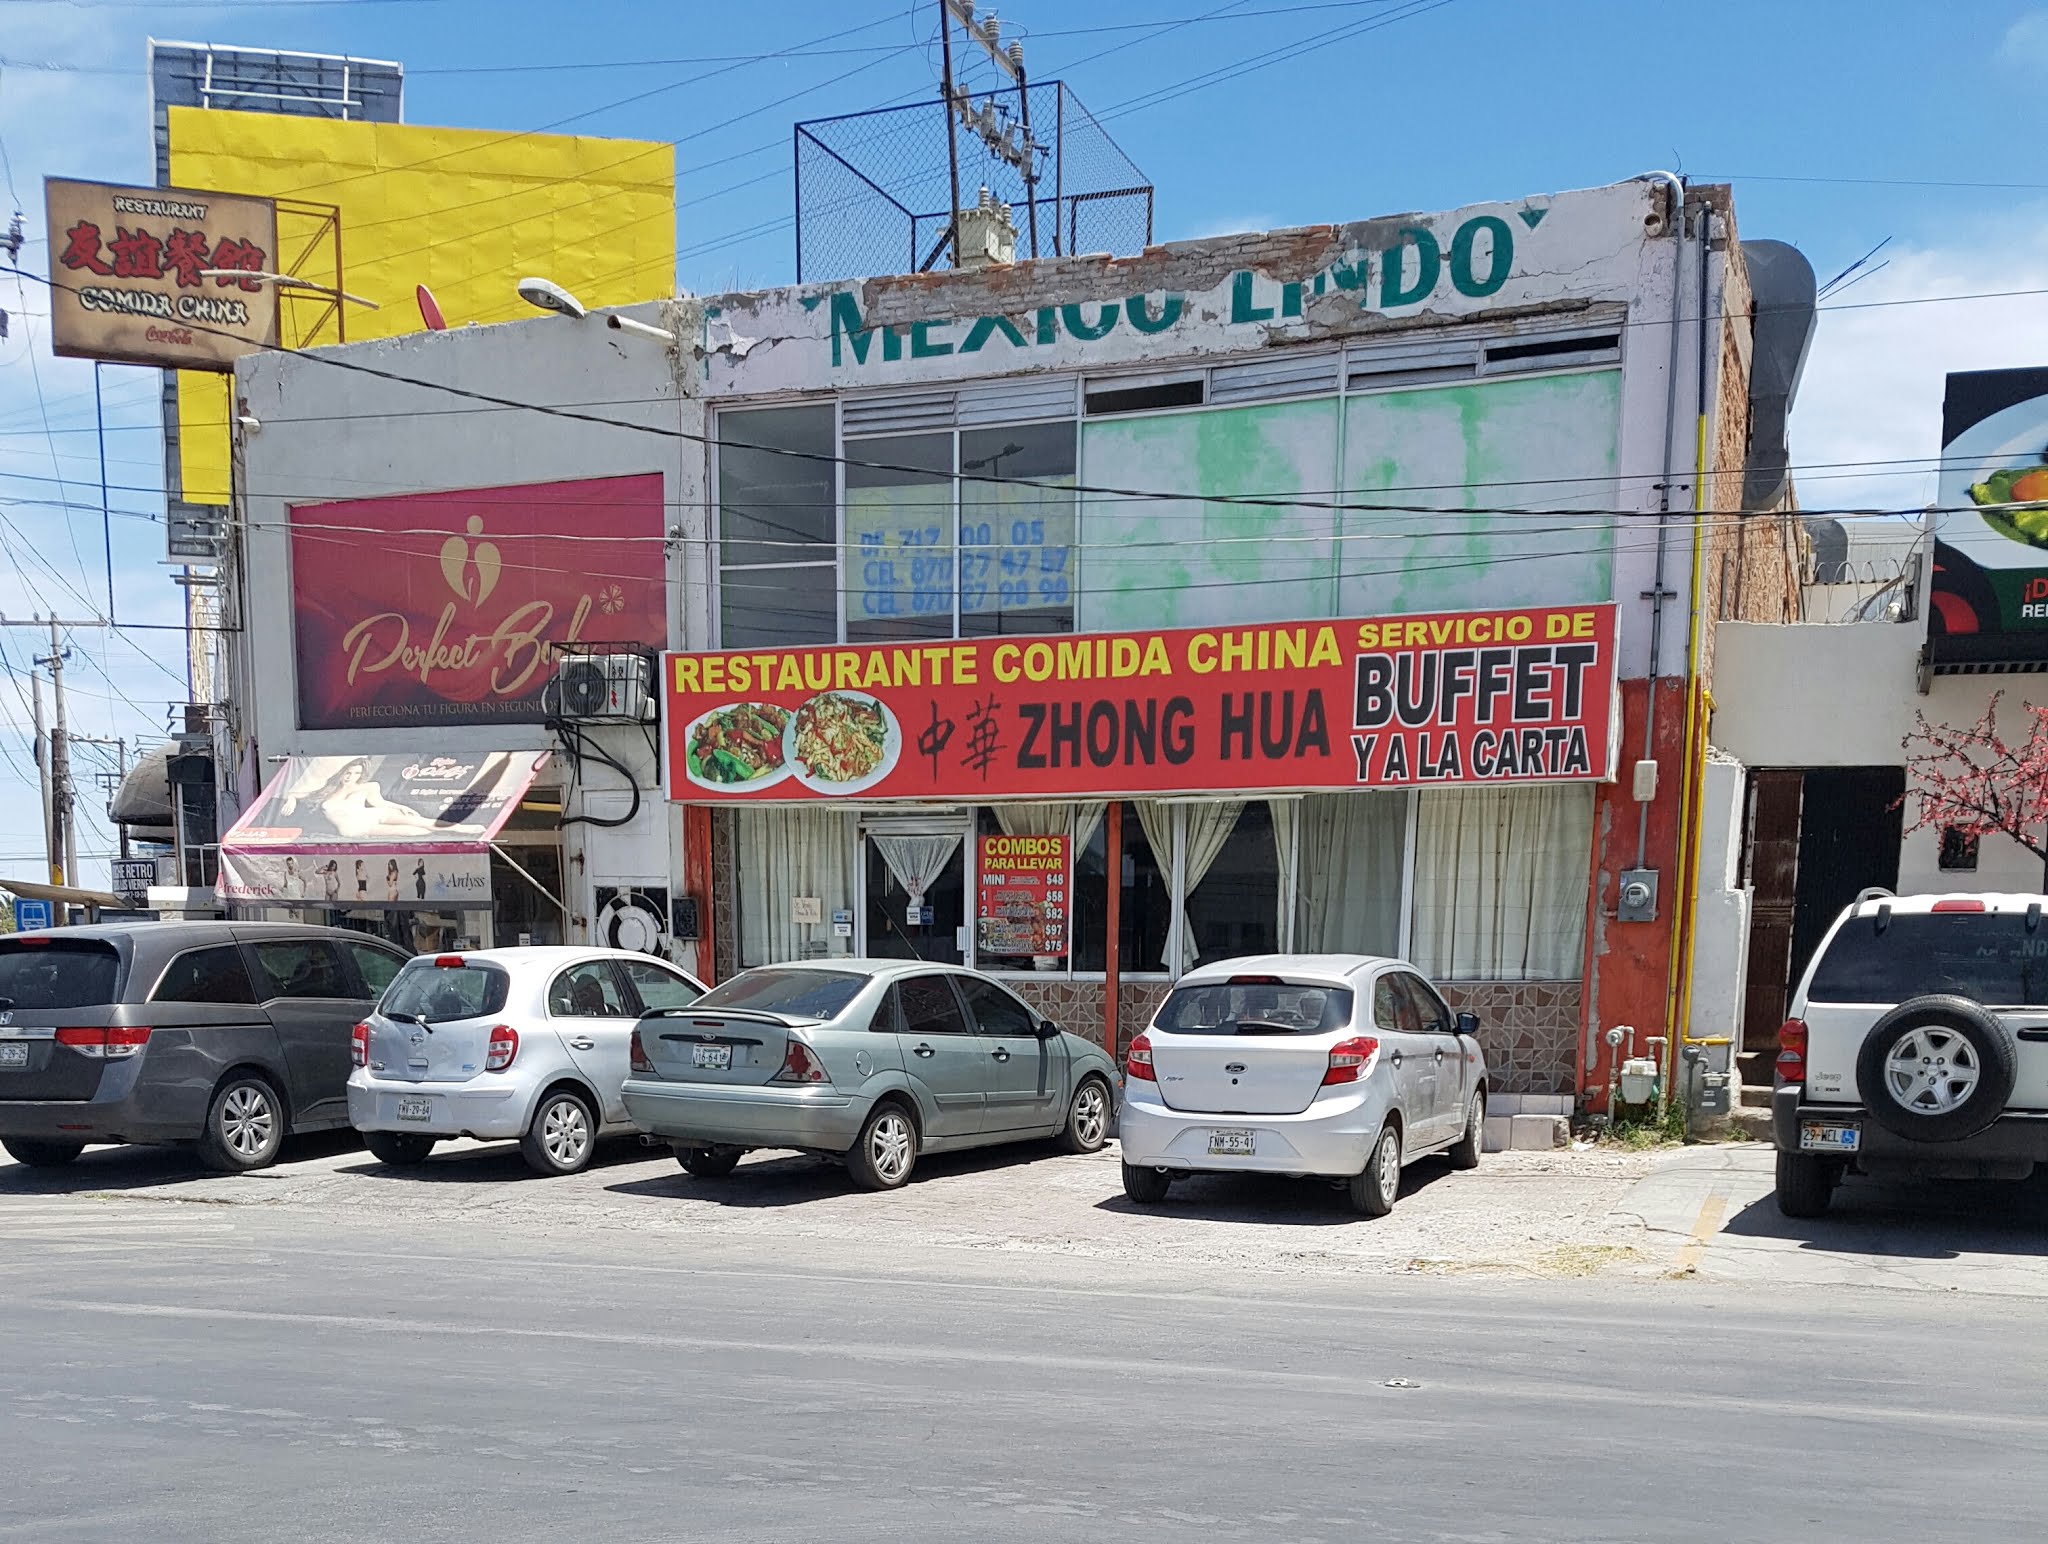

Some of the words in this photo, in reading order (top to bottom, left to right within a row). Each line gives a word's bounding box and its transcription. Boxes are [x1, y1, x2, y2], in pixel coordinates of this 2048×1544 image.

[113, 196, 209, 220] RESTAURANT
[79, 286, 174, 318] COMIDA
[178, 294, 250, 326] CHINA
[2022, 603, 2048, 618] RE
[1357, 615, 1533, 650] SERVICIO
[1545, 612, 1596, 639] DE
[342, 601, 486, 687] Perfect
[674, 646, 979, 694] RESTAURANTE
[992, 635, 1172, 684] COMIDA
[1187, 626, 1343, 675] CHINA
[1352, 641, 1598, 730] BUFFET
[440, 702, 479, 715] FIGURA
[1016, 695, 1195, 770] ZHONG
[1220, 688, 1331, 761] HUA
[1351, 733, 1380, 783] Y
[1381, 732, 1411, 782] A
[1417, 728, 1465, 780] LA
[1470, 726, 1592, 778] CARTA
[985, 837, 1062, 856] COMBOS
[126, 864, 154, 879] RETRO
[984, 858, 1016, 870] PARA
[1017, 858, 1063, 870] LLEVAR
[982, 874, 1005, 885] MINI
[1046, 874, 1064, 886] $48
[981, 890, 988, 901] 1
[981, 905, 988, 917] 2
[1046, 907, 1063, 919] $82
[980, 923, 988, 934] 3
[1045, 924, 1062, 936] $97
[1814, 1071, 1842, 1083] Jeep
